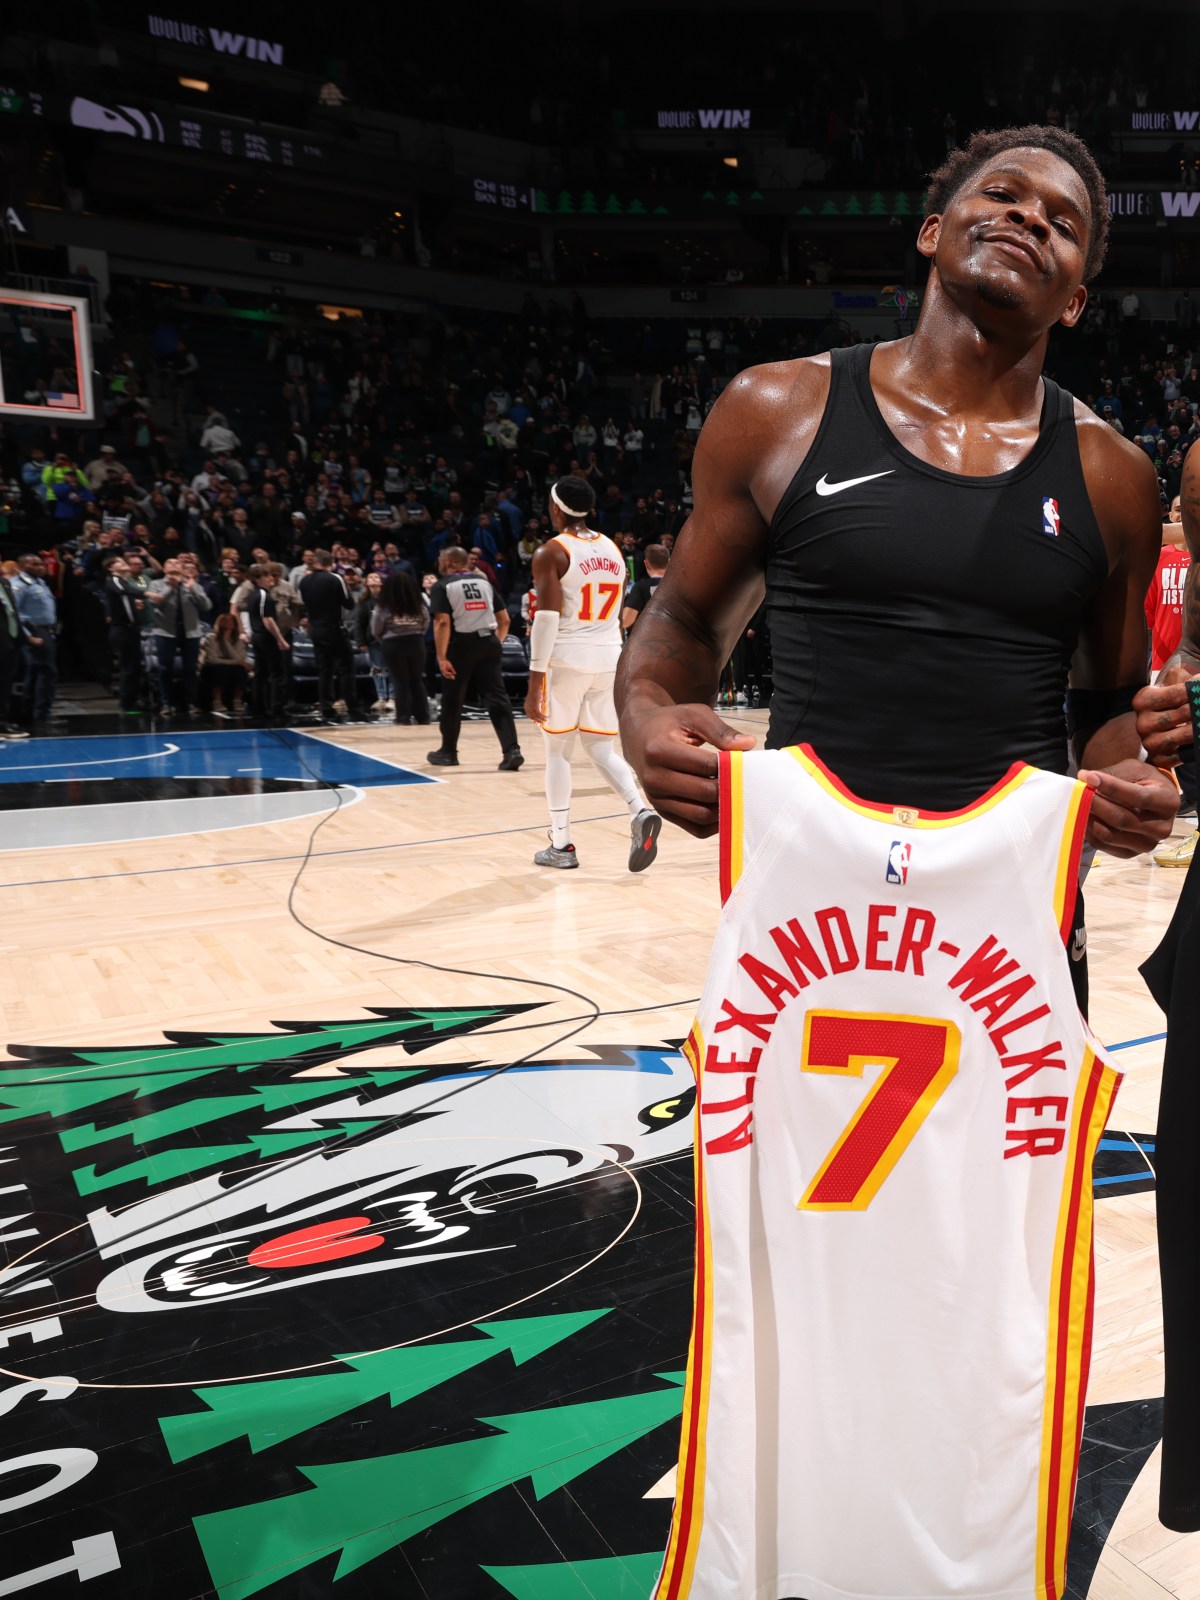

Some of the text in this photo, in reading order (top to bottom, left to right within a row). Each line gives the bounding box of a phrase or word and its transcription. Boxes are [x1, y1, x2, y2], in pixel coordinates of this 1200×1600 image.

[208, 27, 284, 66] WIN
[698, 108, 752, 129] WIN
[579, 557, 621, 576] OKONGWU
[462, 582, 481, 600] 25
[578, 581, 621, 621] 17
[701, 904, 1069, 1160] ALEXANDER-WALKER
[796, 1008, 962, 1212] 7
